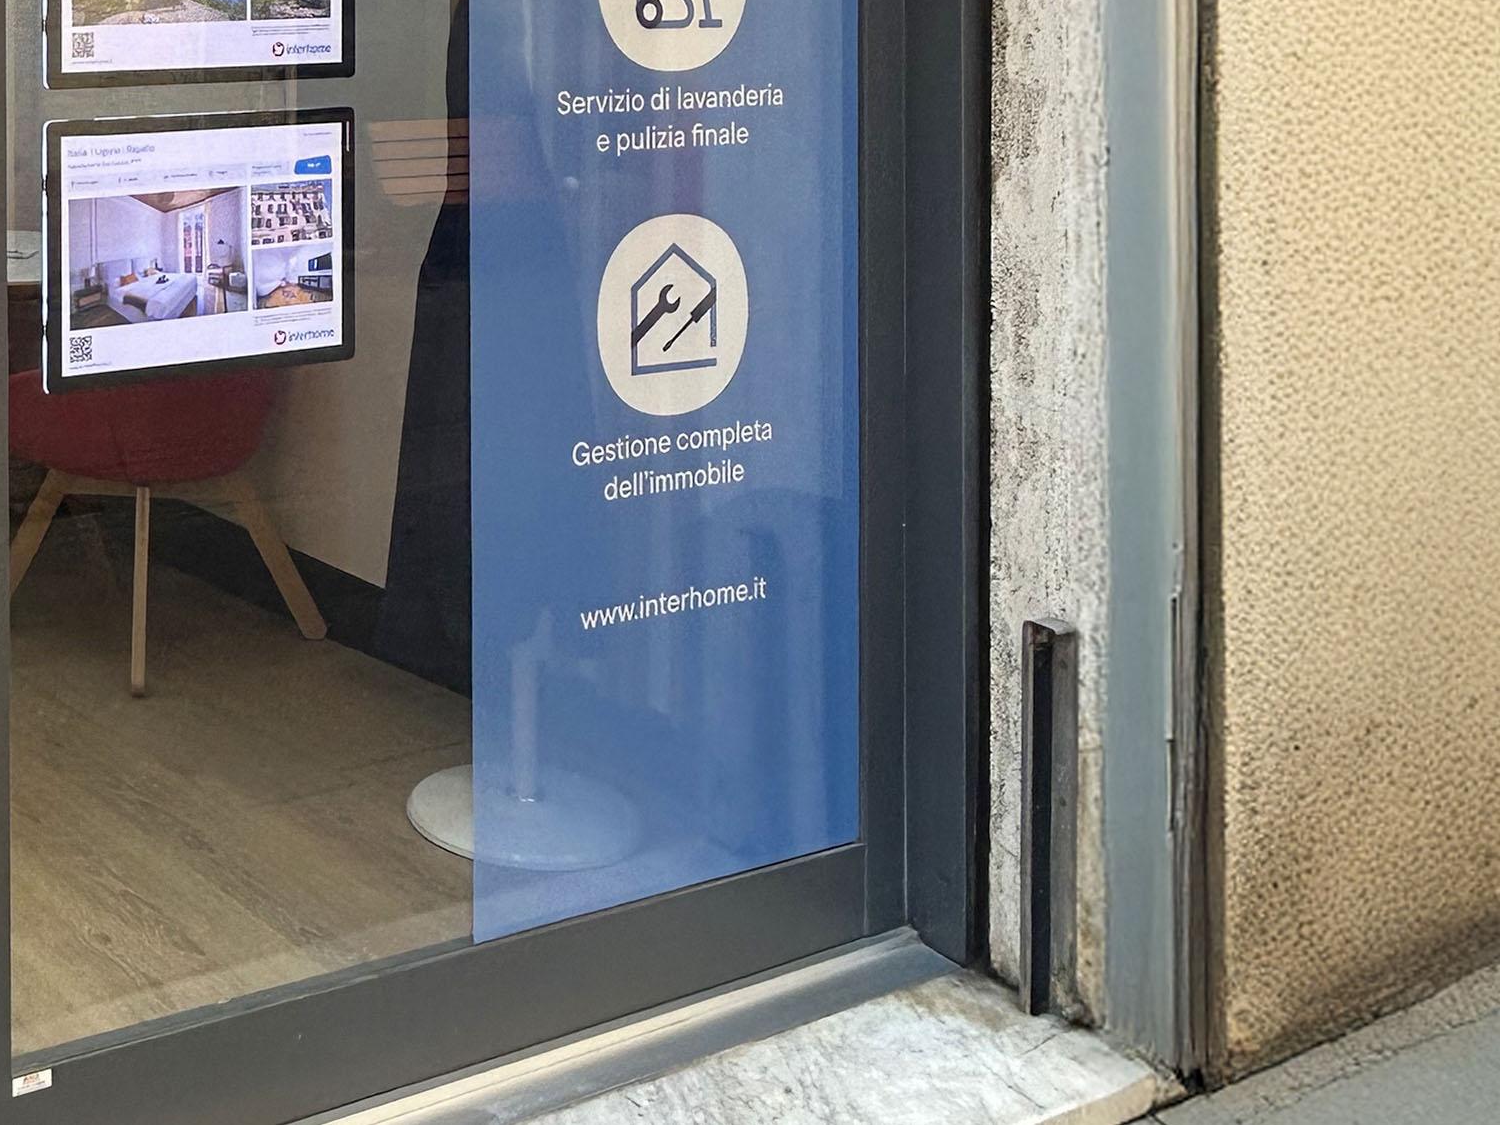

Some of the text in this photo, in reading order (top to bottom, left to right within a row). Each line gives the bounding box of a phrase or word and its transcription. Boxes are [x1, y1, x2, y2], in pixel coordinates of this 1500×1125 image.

[556, 82, 784, 116] Servizio di lavanderia
[596, 121, 750, 157] e pulizia finale
[571, 419, 773, 467] Gestione completa
[579, 576, 767, 631] www.interhome.it
